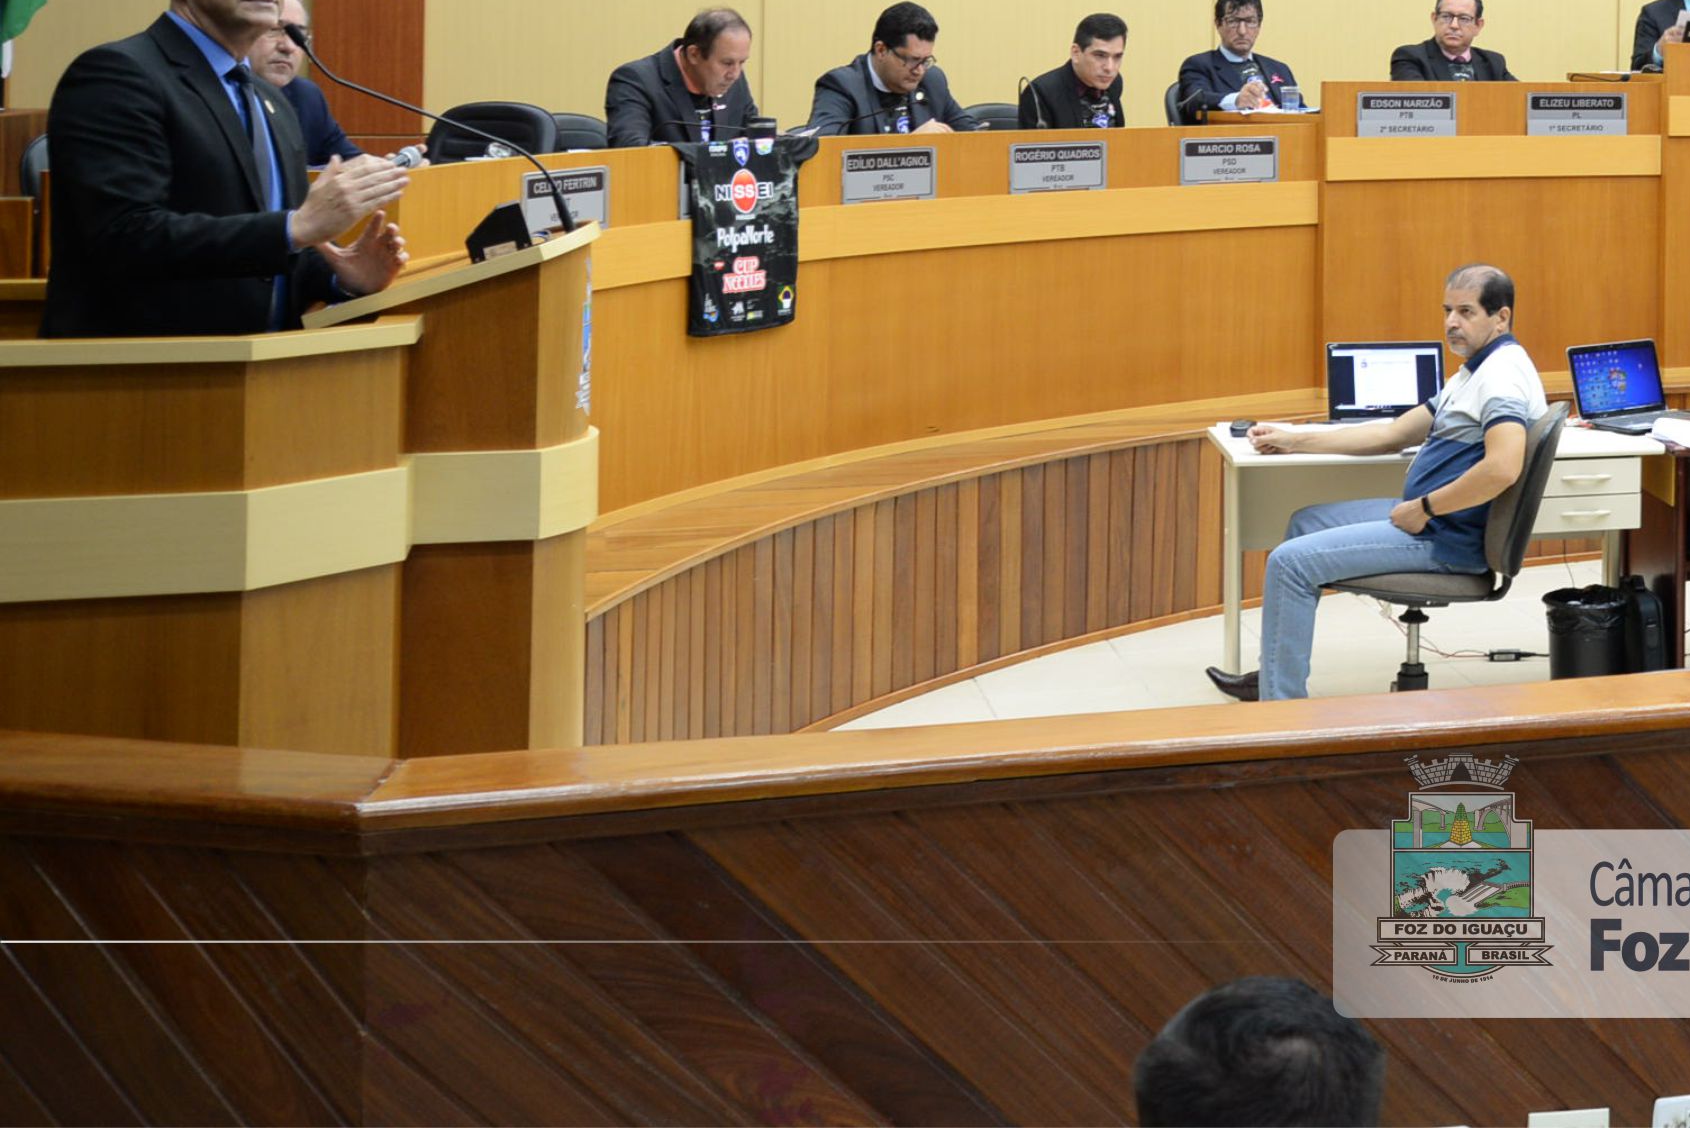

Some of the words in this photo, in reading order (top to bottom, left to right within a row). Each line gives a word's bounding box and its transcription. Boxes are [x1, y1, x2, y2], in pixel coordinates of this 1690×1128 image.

[1370, 99, 1401, 107] EDSON
[1403, 98, 1443, 107] NARIZÃO
[1540, 99, 1570, 107] ELIZEU
[1572, 99, 1614, 107] LIBERATO
[1198, 145, 1234, 153] MARCIO
[1235, 144, 1261, 152] ROSA
[1015, 149, 1056, 161] ROGÉRIO
[1057, 149, 1100, 159] QUADROS
[877, 156, 929, 167] DALL'AGNOL
[564, 176, 596, 190] FERTRIN
[715, 182, 773, 201] NISSEI
[717, 224, 774, 253] PolpaNorte
[733, 256, 759, 274] CUP
